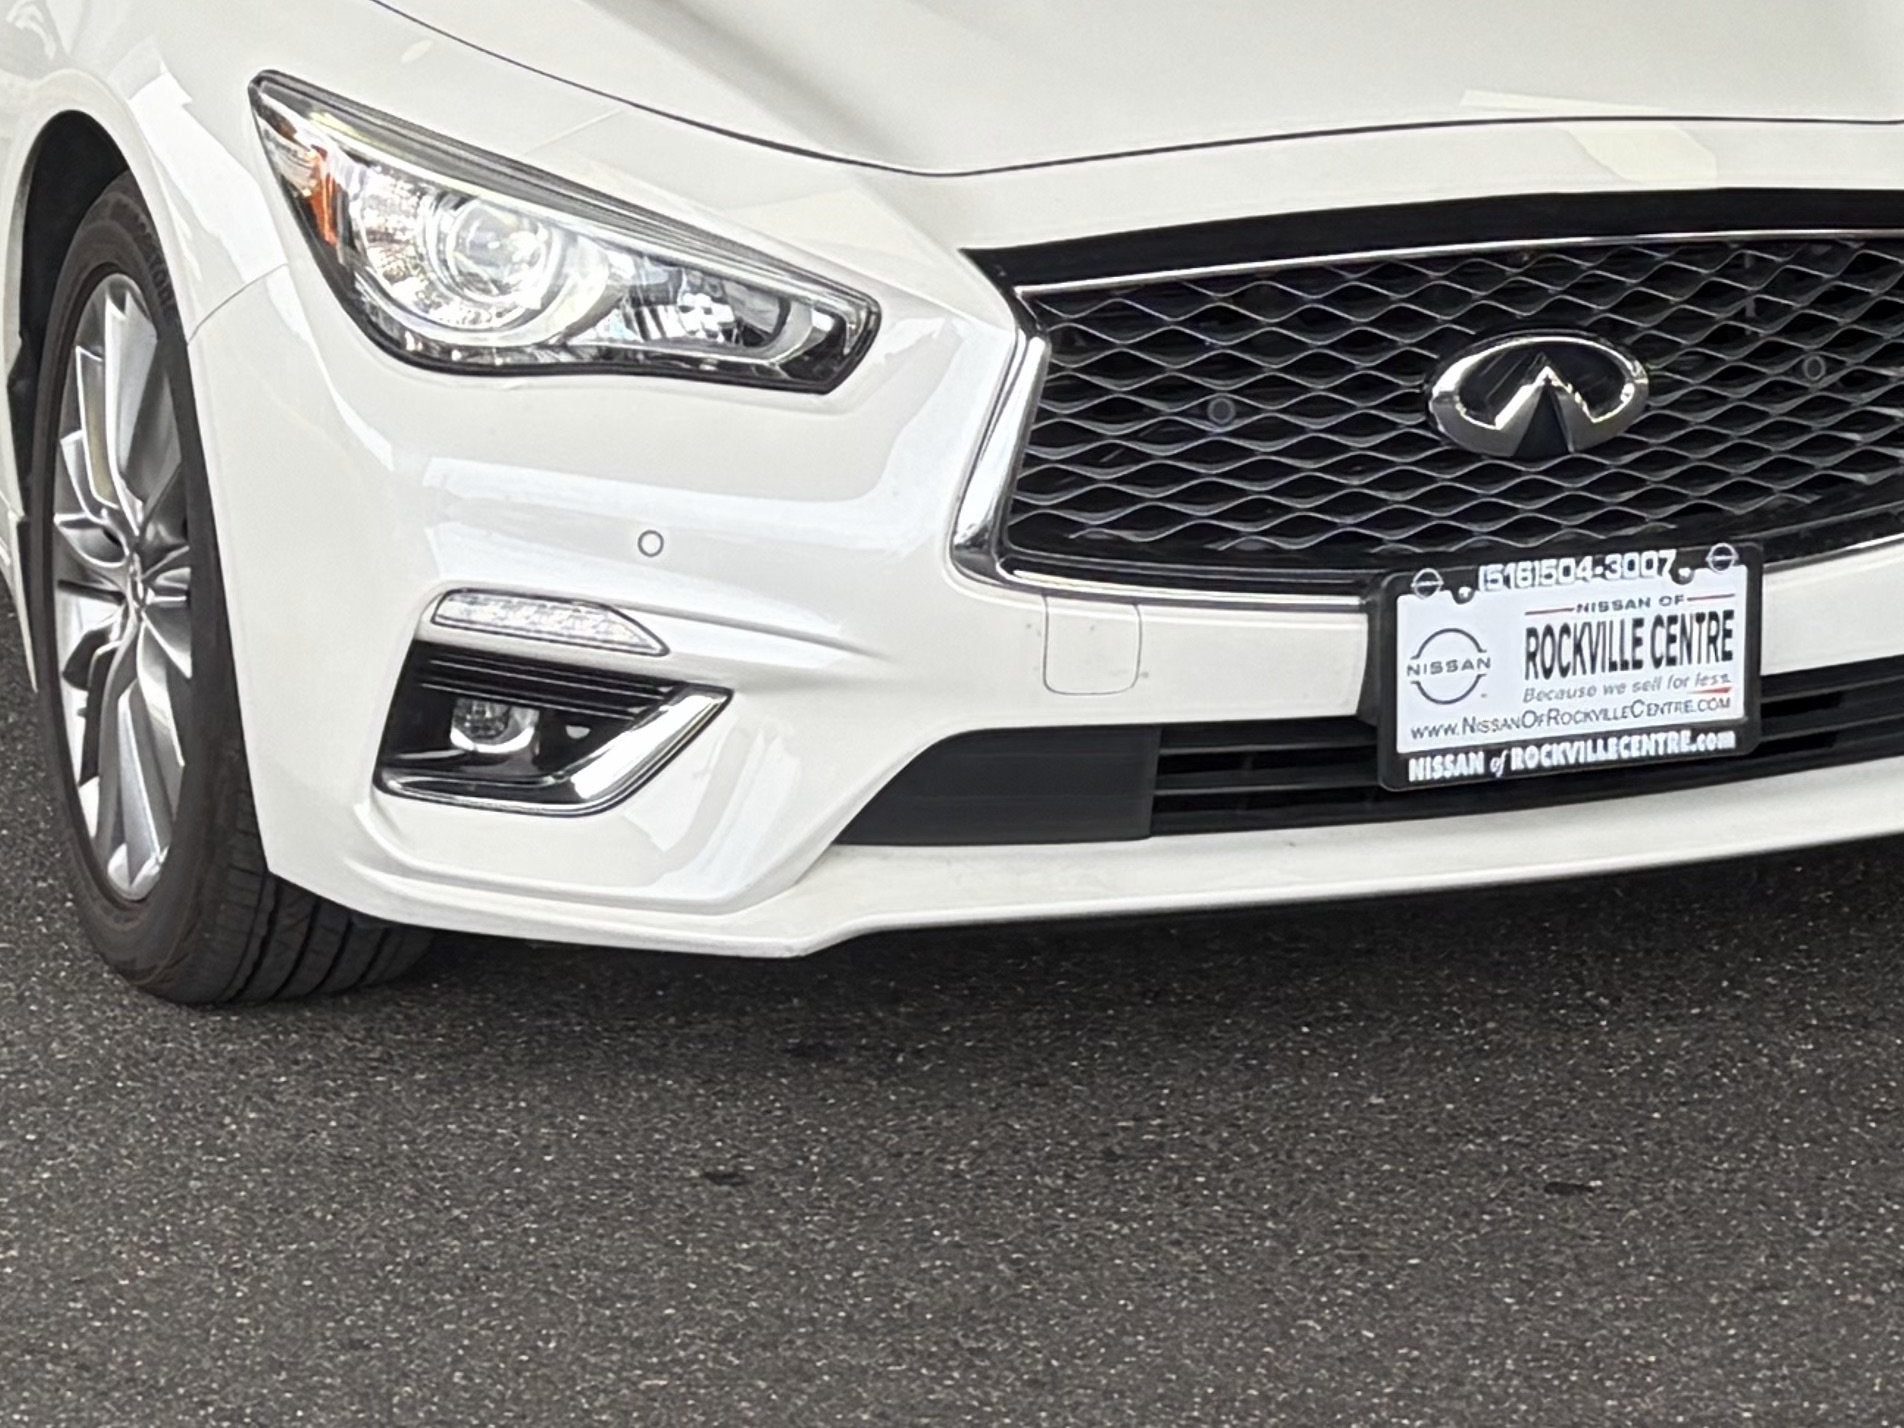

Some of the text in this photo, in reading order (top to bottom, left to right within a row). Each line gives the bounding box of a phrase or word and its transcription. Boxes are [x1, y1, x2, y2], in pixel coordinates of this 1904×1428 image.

[1575, 594, 1685, 614] NISSAN OF
[1524, 609, 1734, 681] ROCKVILLE CENTRE
[1406, 656, 1492, 678] NISSAN
[1522, 682, 1597, 704] Because
[1601, 683, 1629, 697] we
[1631, 675, 1662, 694] sell
[1667, 673, 1690, 689] for
[1408, 752, 1486, 784] NISSAN
[1489, 753, 1507, 778] of
